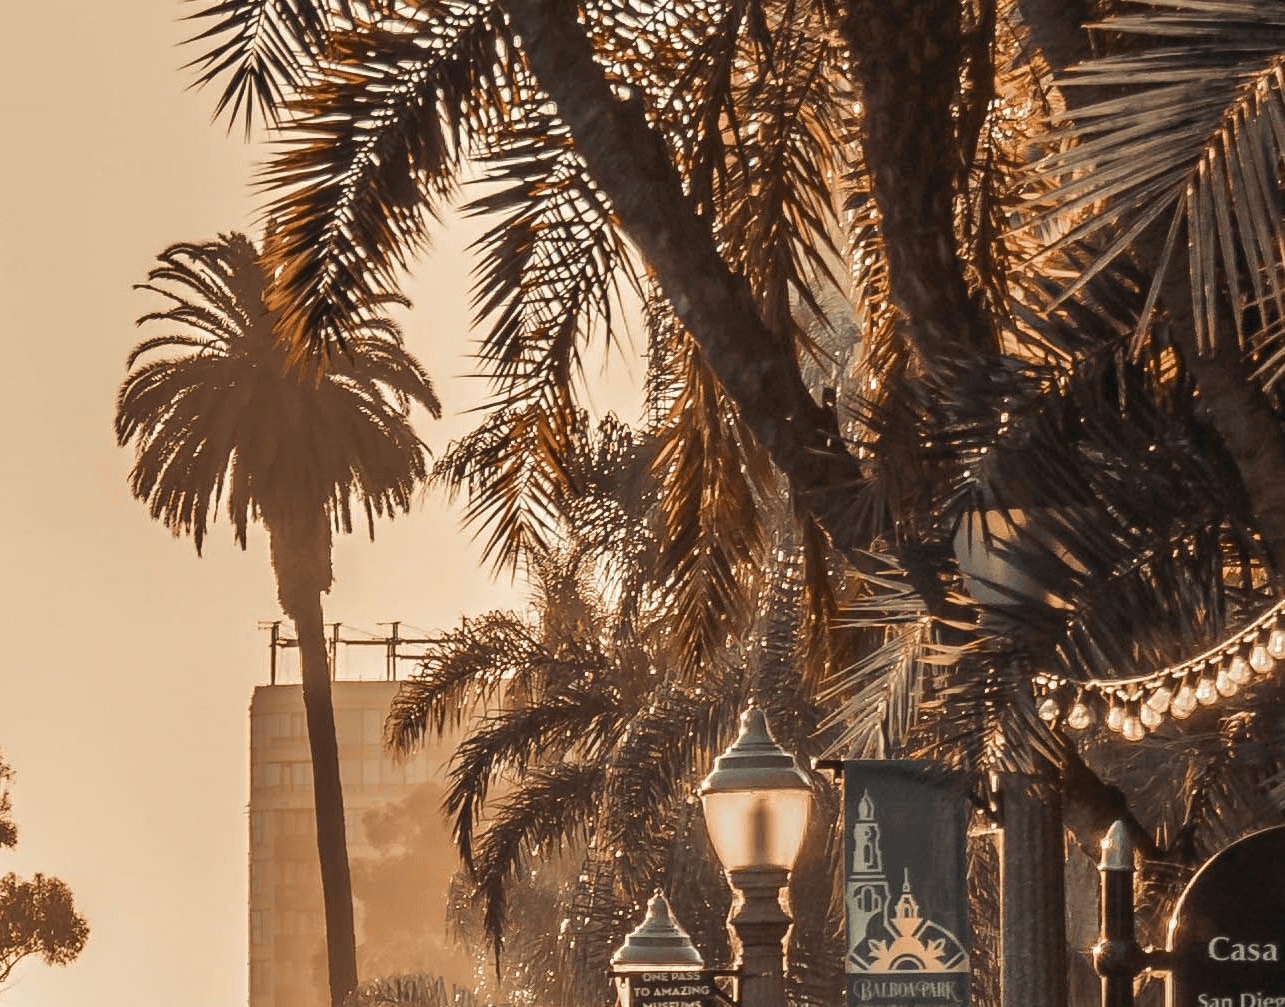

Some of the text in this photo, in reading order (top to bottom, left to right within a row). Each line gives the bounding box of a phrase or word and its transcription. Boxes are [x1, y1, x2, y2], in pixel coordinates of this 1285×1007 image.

[1208, 936, 1278, 961] Casa
[642, 971, 701, 982] ONE PASS
[634, 985, 710, 997] TO AMAZING
